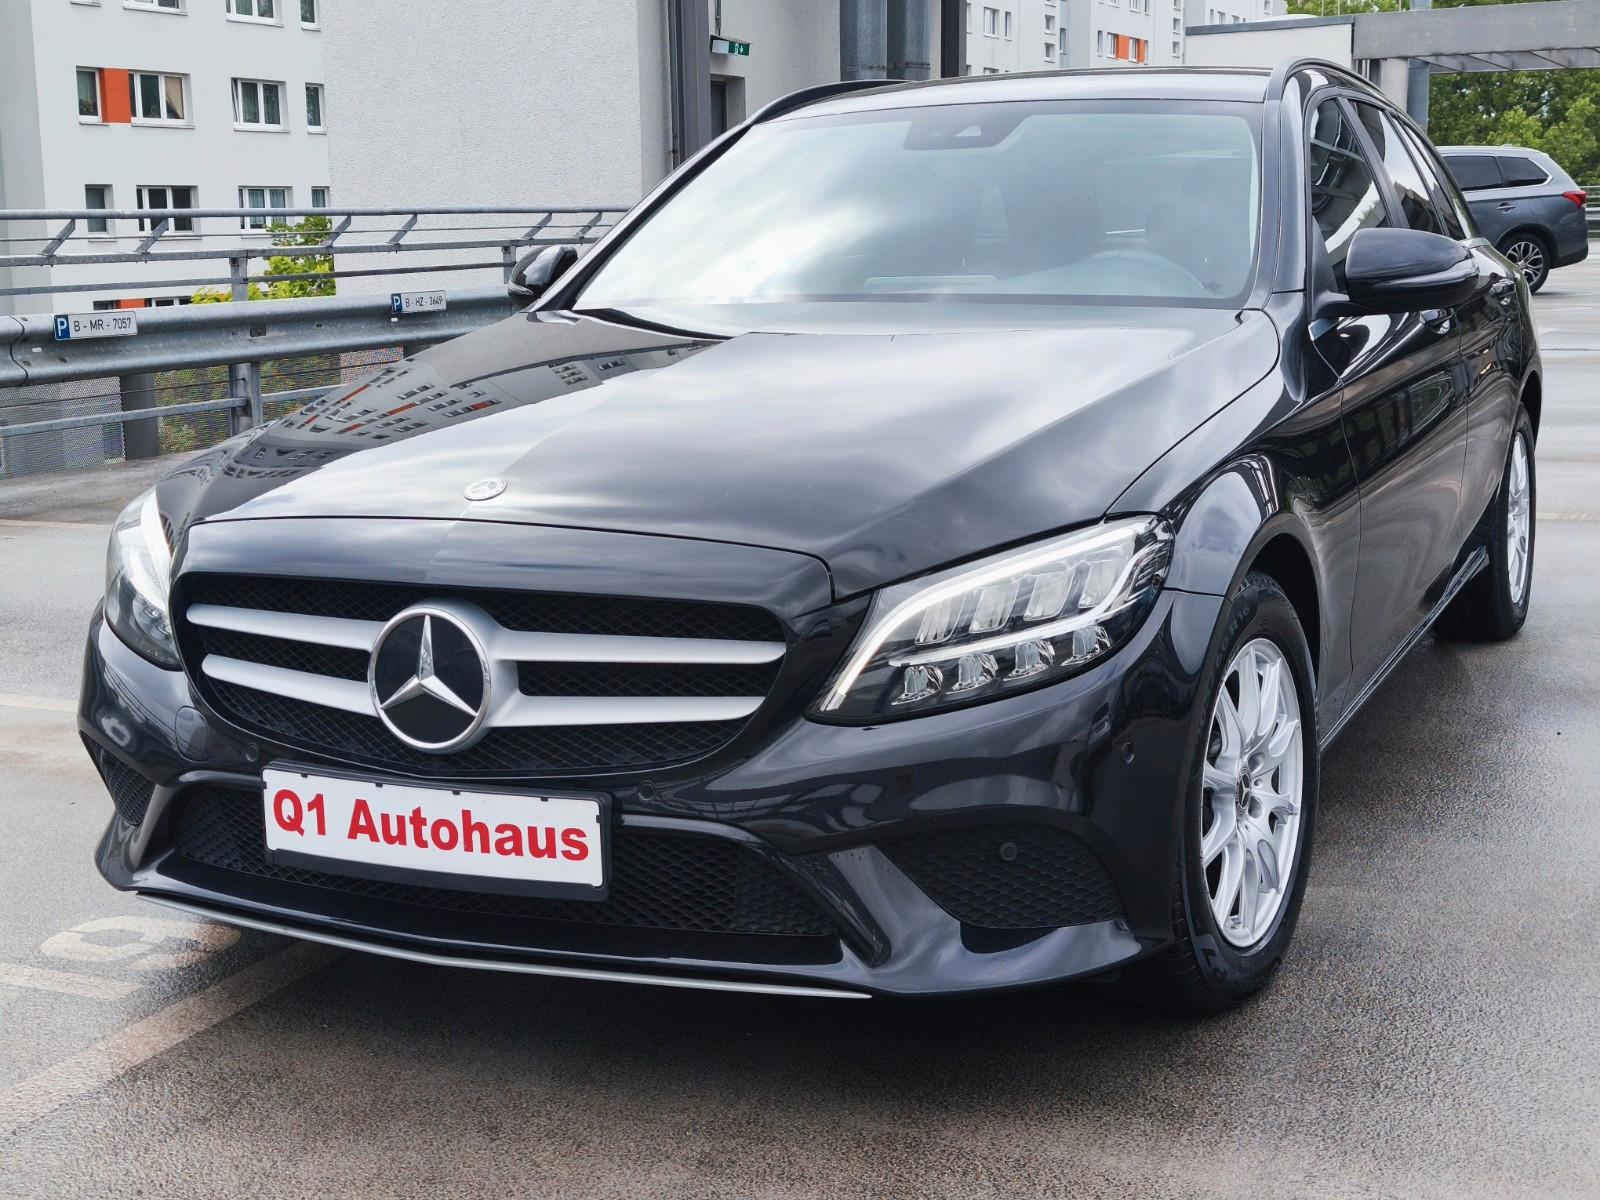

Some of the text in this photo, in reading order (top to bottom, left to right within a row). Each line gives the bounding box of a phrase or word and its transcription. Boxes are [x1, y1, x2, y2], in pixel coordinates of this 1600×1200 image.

[393, 296, 401, 311] P
[415, 297, 424, 306] HZ
[56, 317, 67, 336] P
[73, 320, 81, 332] B
[89, 319, 104, 331] MR
[112, 317, 132, 329] 7057
[273, 789, 589, 862] Q1 Autohaus
